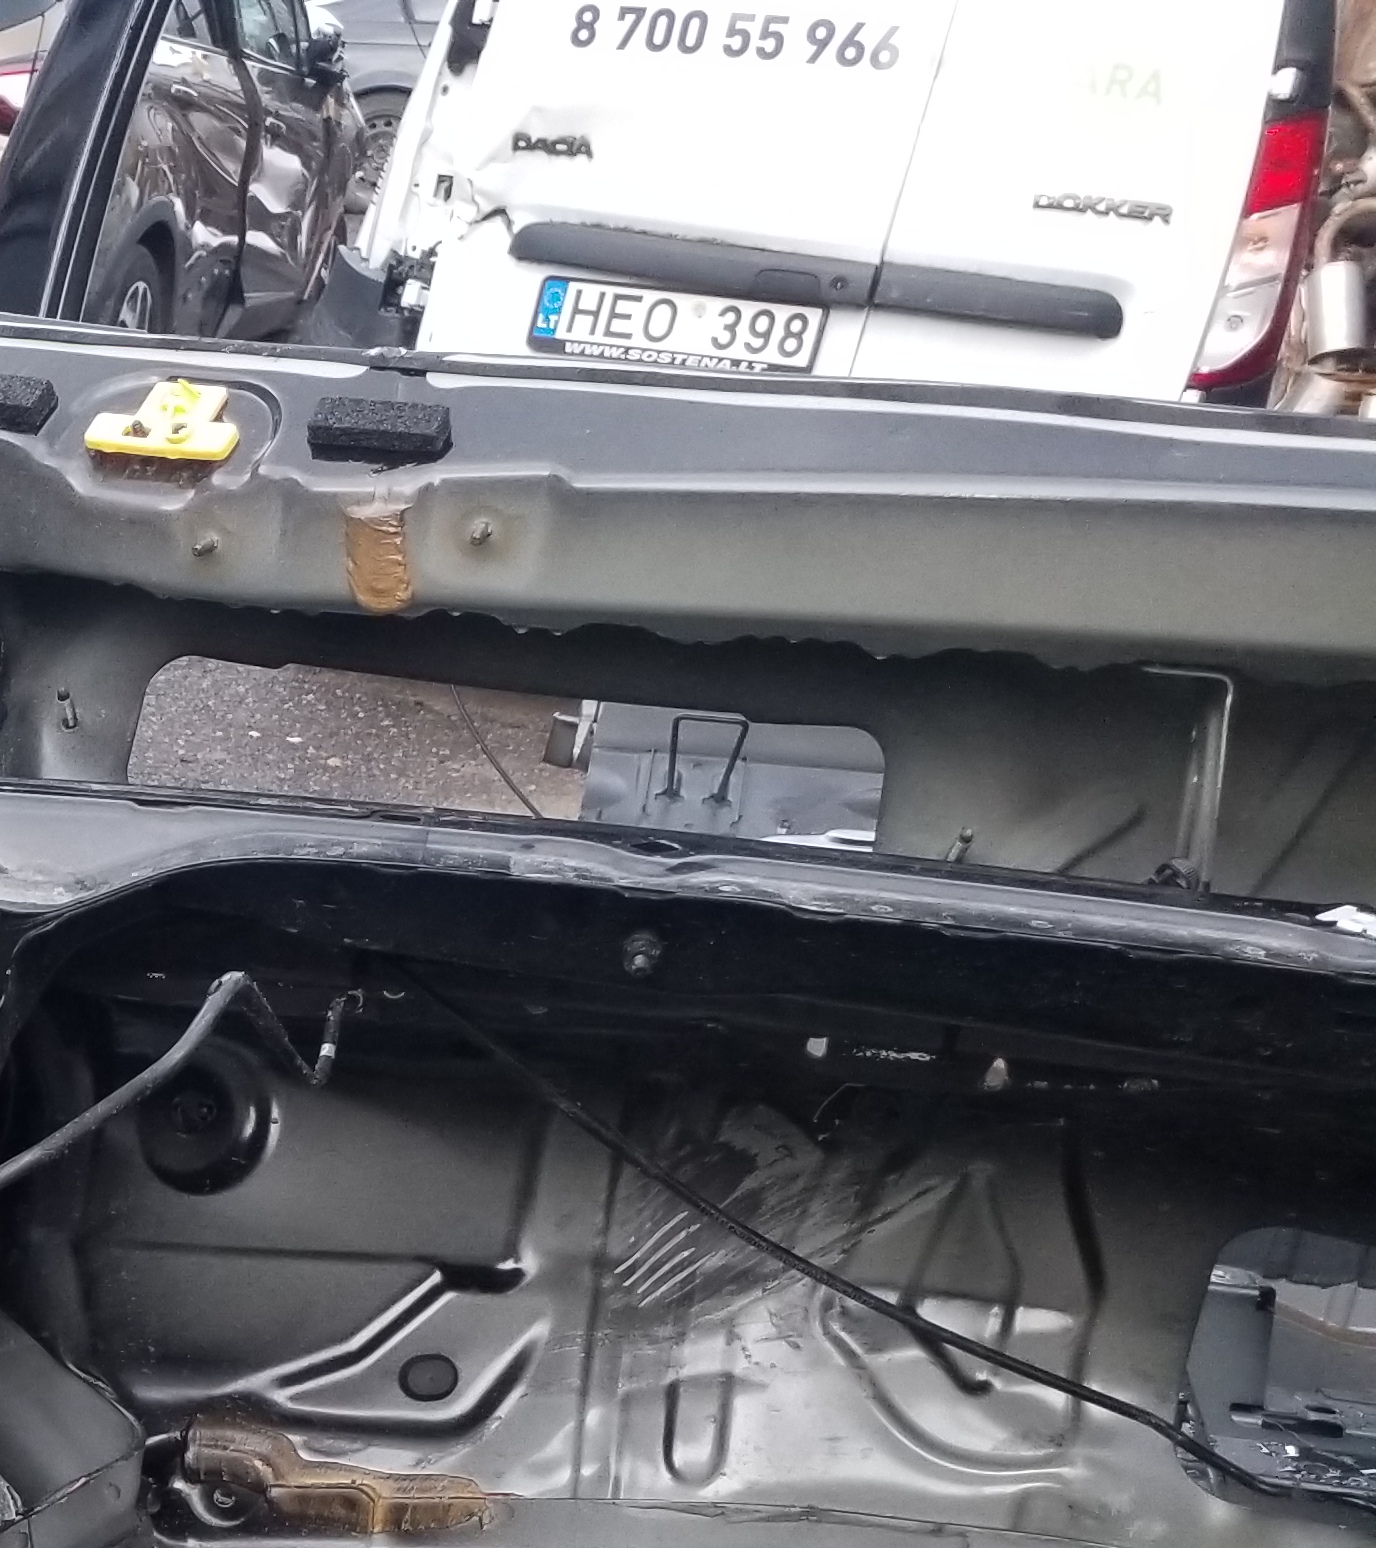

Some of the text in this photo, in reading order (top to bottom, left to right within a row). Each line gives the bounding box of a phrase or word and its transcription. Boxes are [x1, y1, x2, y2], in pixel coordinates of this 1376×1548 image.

[570, 3, 900, 70] 8 700 55 966
[1033, 192, 1173, 226] DOKKER
[536, 312, 559, 330] LT
[565, 288, 810, 359] HEO 398
